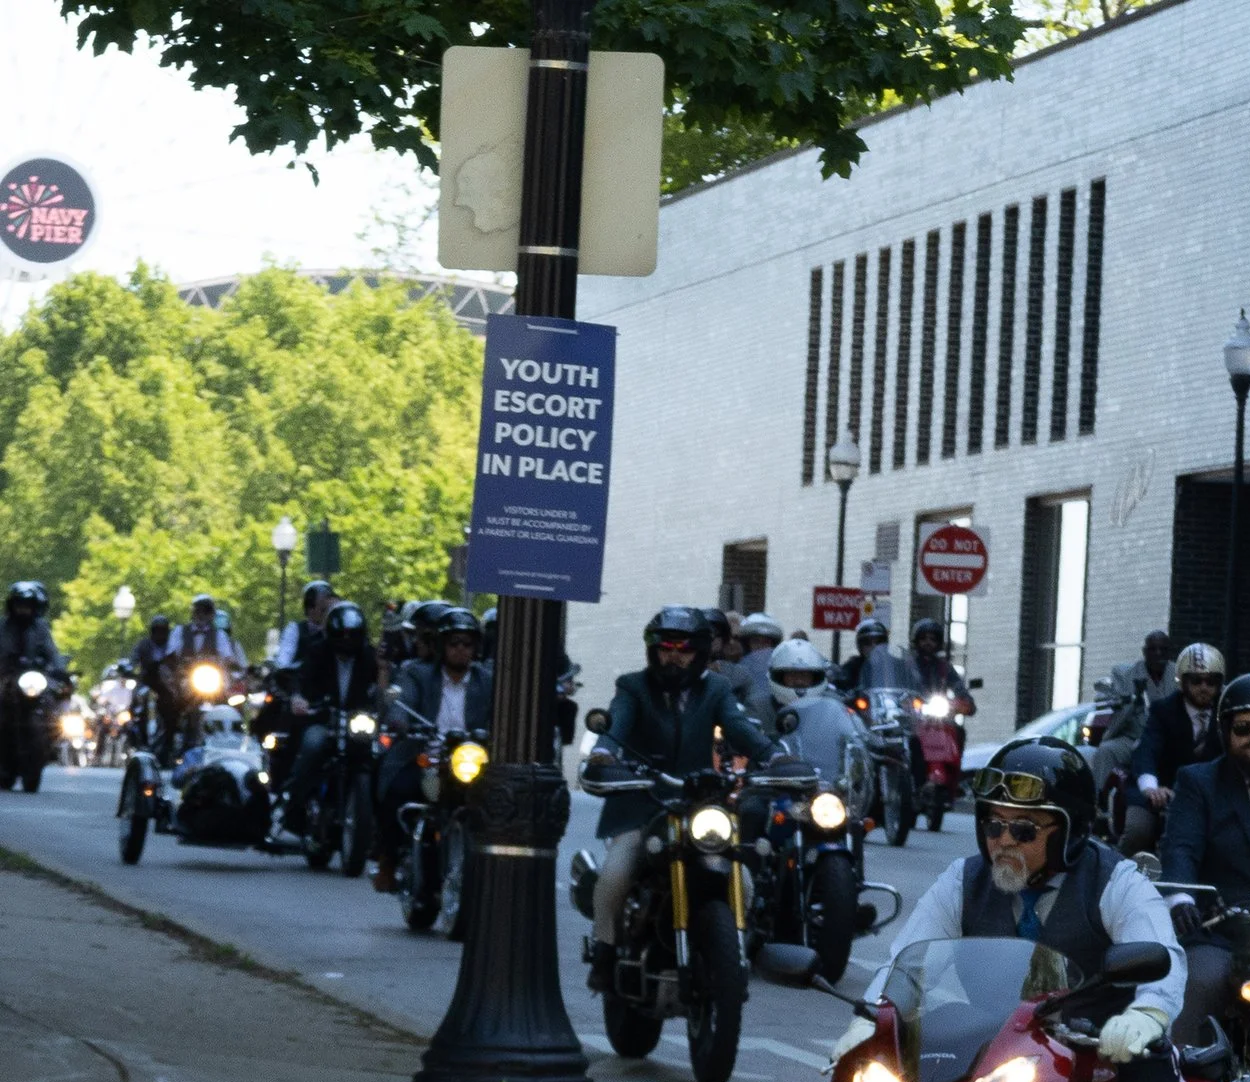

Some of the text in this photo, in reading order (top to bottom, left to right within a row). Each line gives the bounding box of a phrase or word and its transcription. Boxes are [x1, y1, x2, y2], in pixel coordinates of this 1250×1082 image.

[32, 207, 88, 226] NAVY
[30, 225, 83, 243] PIER
[500, 358, 599, 388] YOUTH
[494, 389, 602, 420] ESCORT
[495, 422, 597, 452] POLICY
[482, 453, 604, 484] IN PLACE
[540, 509, 567, 518] UNDER
[486, 516, 510, 526] MUST
[522, 520, 580, 532] ACCOMPANIED
[485, 528, 515, 538] PARENT
[517, 530, 529, 539] OR
[530, 532, 555, 541] LEGAL
[556, 534, 599, 545] GUARDIAN
[930, 538, 979, 552] DO NOT
[932, 569, 973, 583] ENTER
[816, 591, 865, 606] WRONG
[823, 610, 855, 625] WAY
